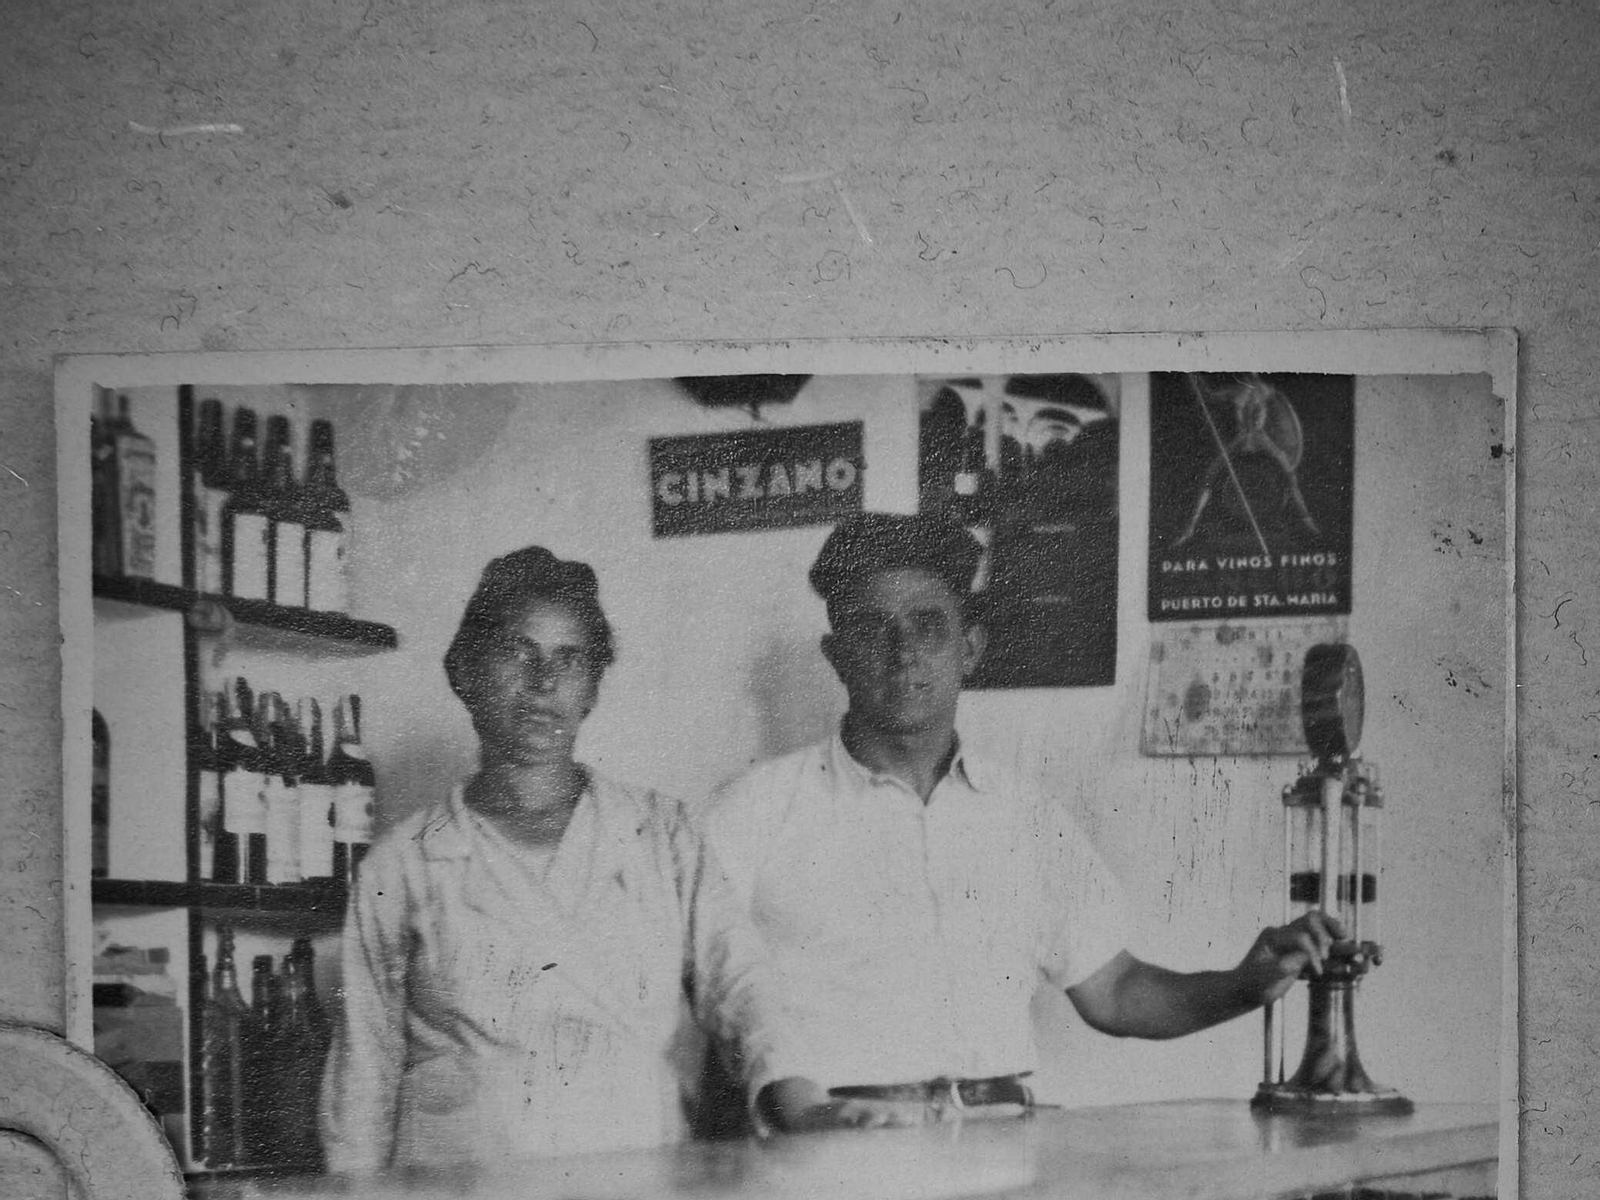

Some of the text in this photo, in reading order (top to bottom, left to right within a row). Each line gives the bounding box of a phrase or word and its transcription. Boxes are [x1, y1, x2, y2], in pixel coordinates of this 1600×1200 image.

[656, 456, 856, 506] CINZANO
[1161, 552, 1337, 573] PARA VINOS FINOS
[1160, 596, 1223, 611] PUERTO
[1227, 595, 1247, 608] DE
[1286, 592, 1338, 606] MARIA
